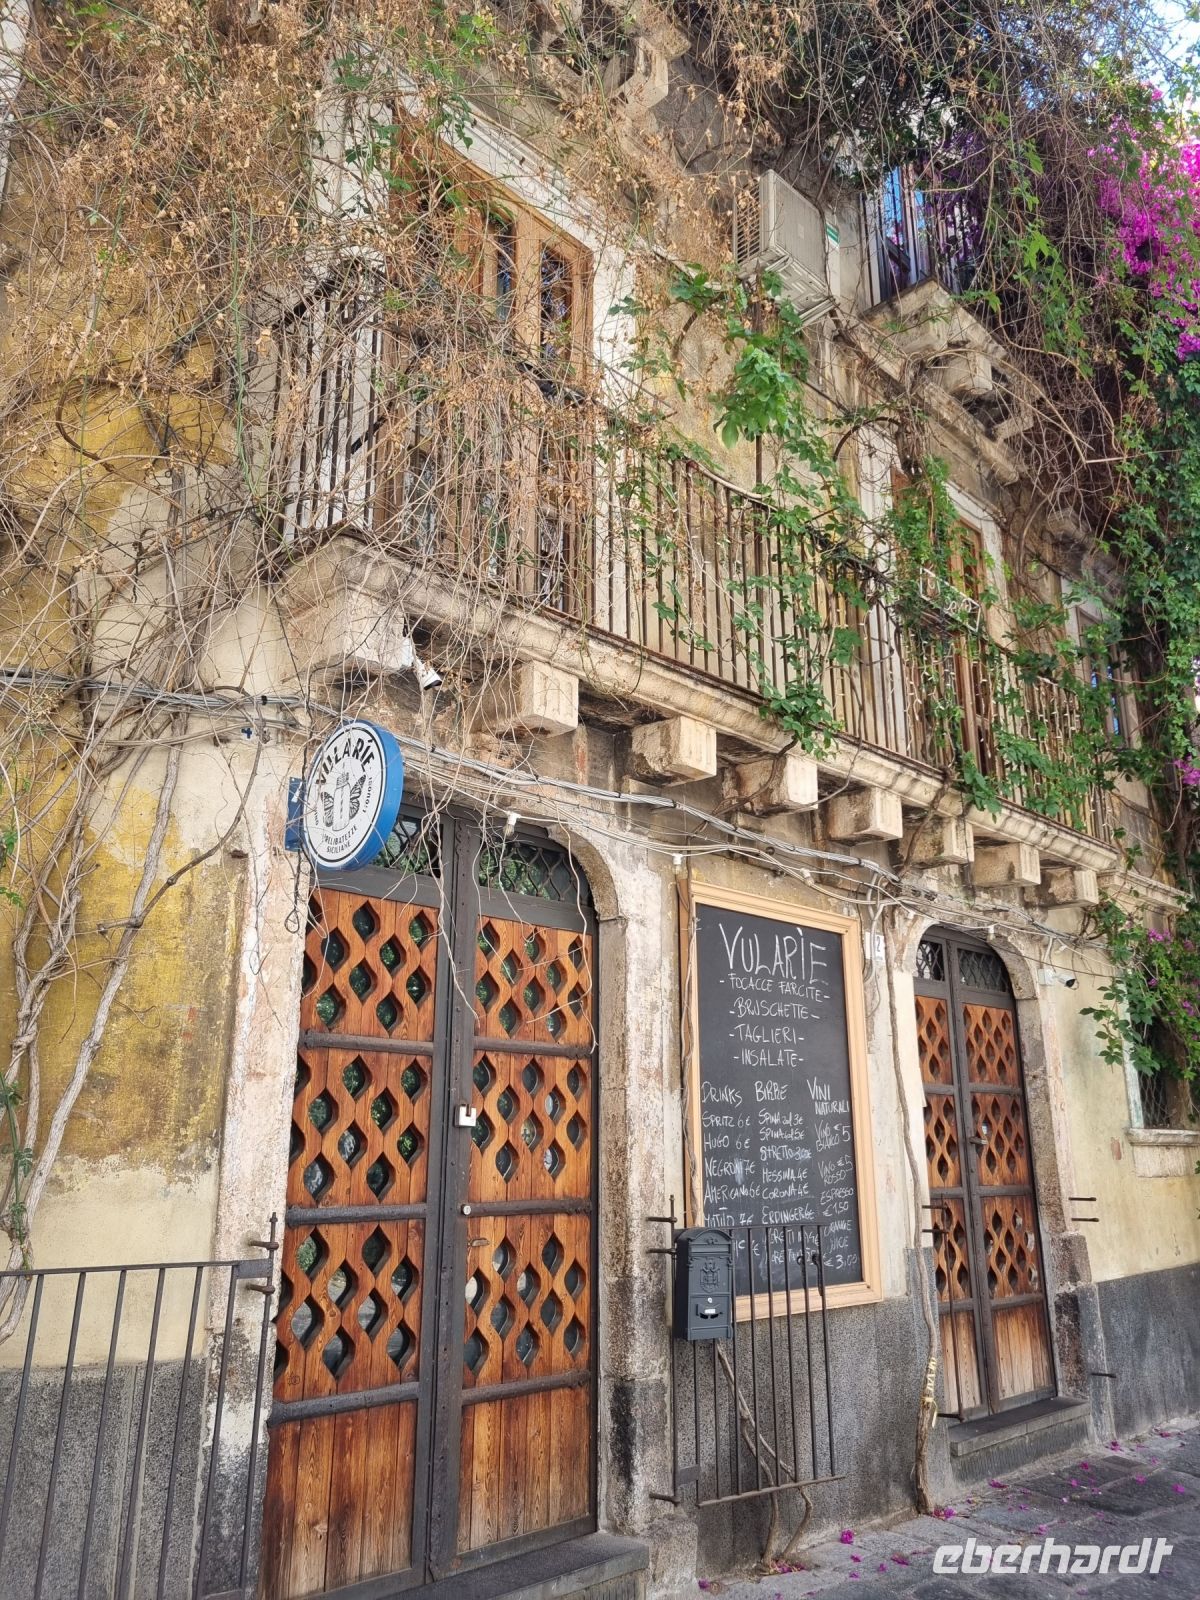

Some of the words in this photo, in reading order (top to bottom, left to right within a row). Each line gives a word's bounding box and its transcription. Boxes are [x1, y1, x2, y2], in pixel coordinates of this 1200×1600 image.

[701, 1081, 742, 1108] DRINKS
[807, 1076, 831, 1100] VINI
[702, 1111, 735, 1128] SPRITZ
[704, 1133, 729, 1152] HUGO
